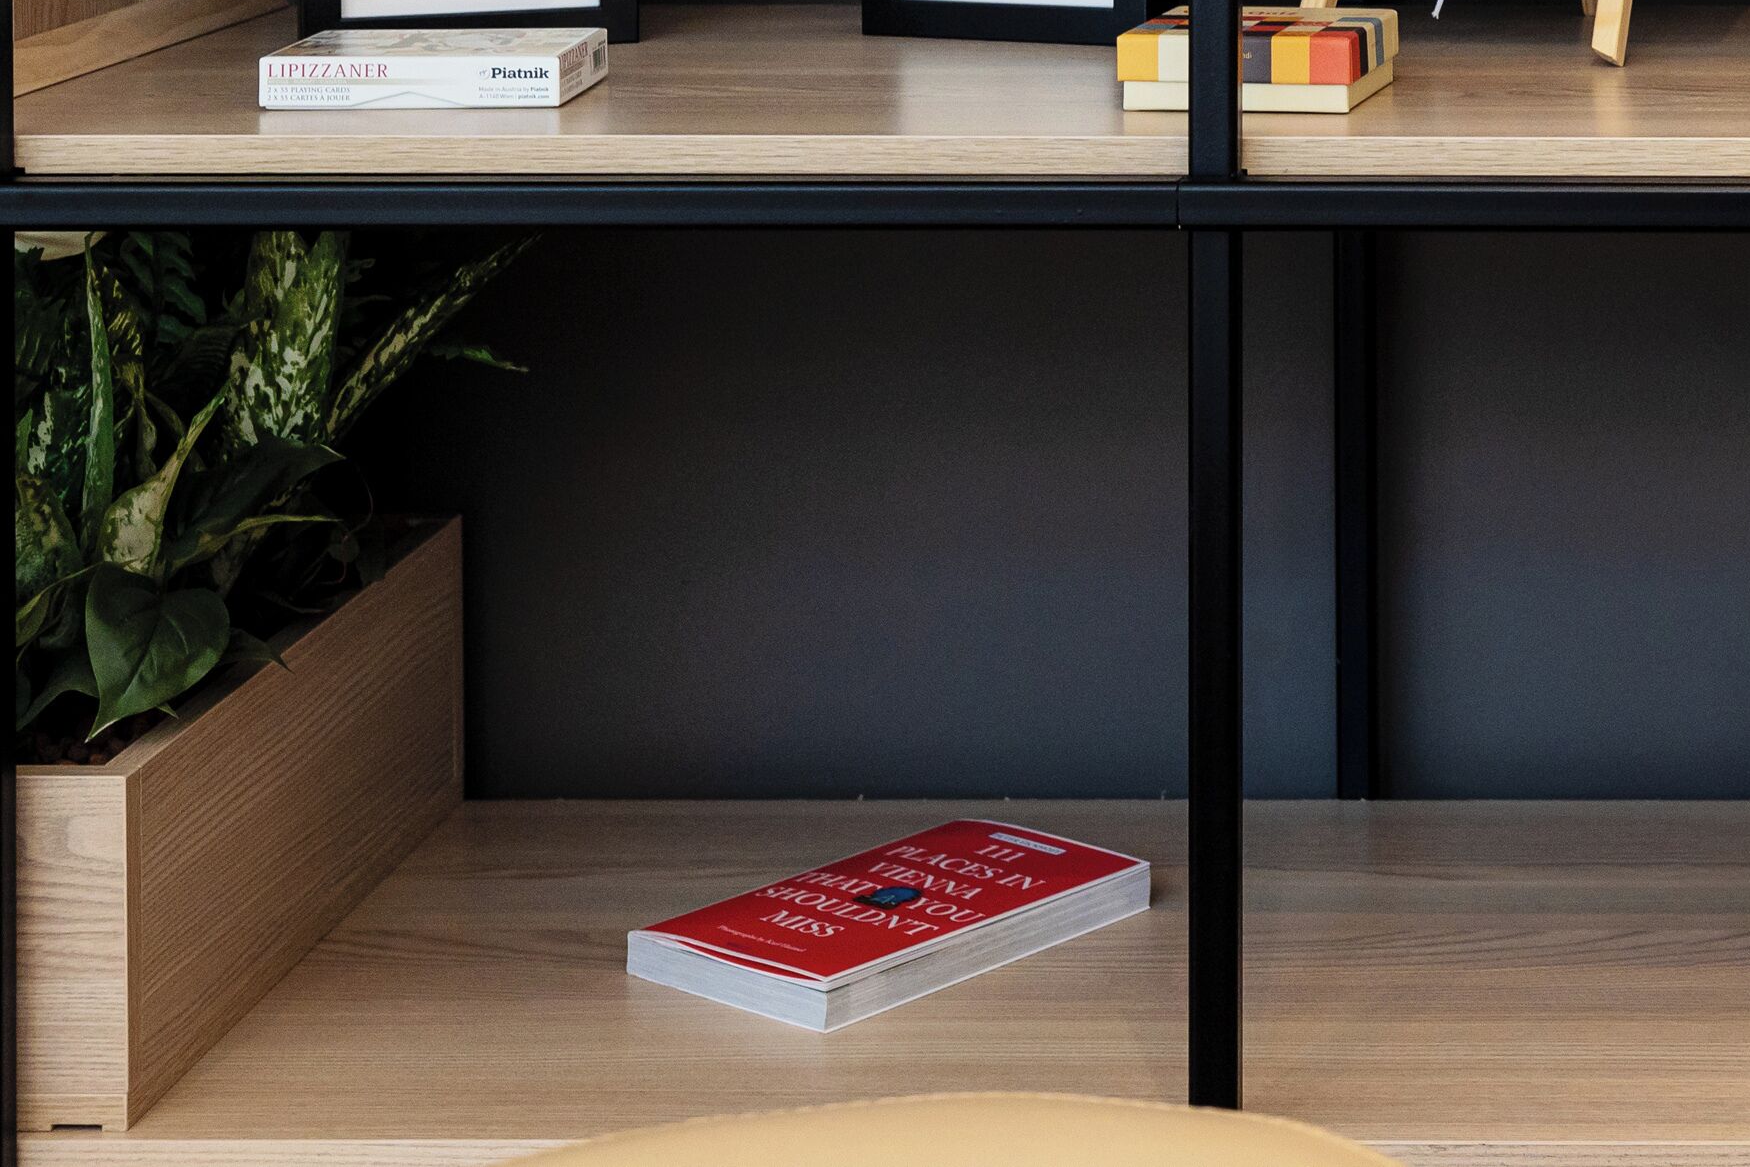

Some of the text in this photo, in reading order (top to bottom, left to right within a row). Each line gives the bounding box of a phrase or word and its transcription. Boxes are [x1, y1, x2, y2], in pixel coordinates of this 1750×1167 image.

[268, 63, 388, 78] LIPIZZANER
[491, 67, 550, 79] Piatnik
[290, 86, 323, 94] PLAYING
[325, 86, 351, 94] CARDS
[326, 94, 350, 102] JOUER
[974, 845, 1025, 862] 111
[884, 845, 1047, 890] PLACES IN
[868, 862, 983, 900] VIENNA
[794, 872, 986, 923] THAT YOU
[760, 909, 845, 937] MISS
